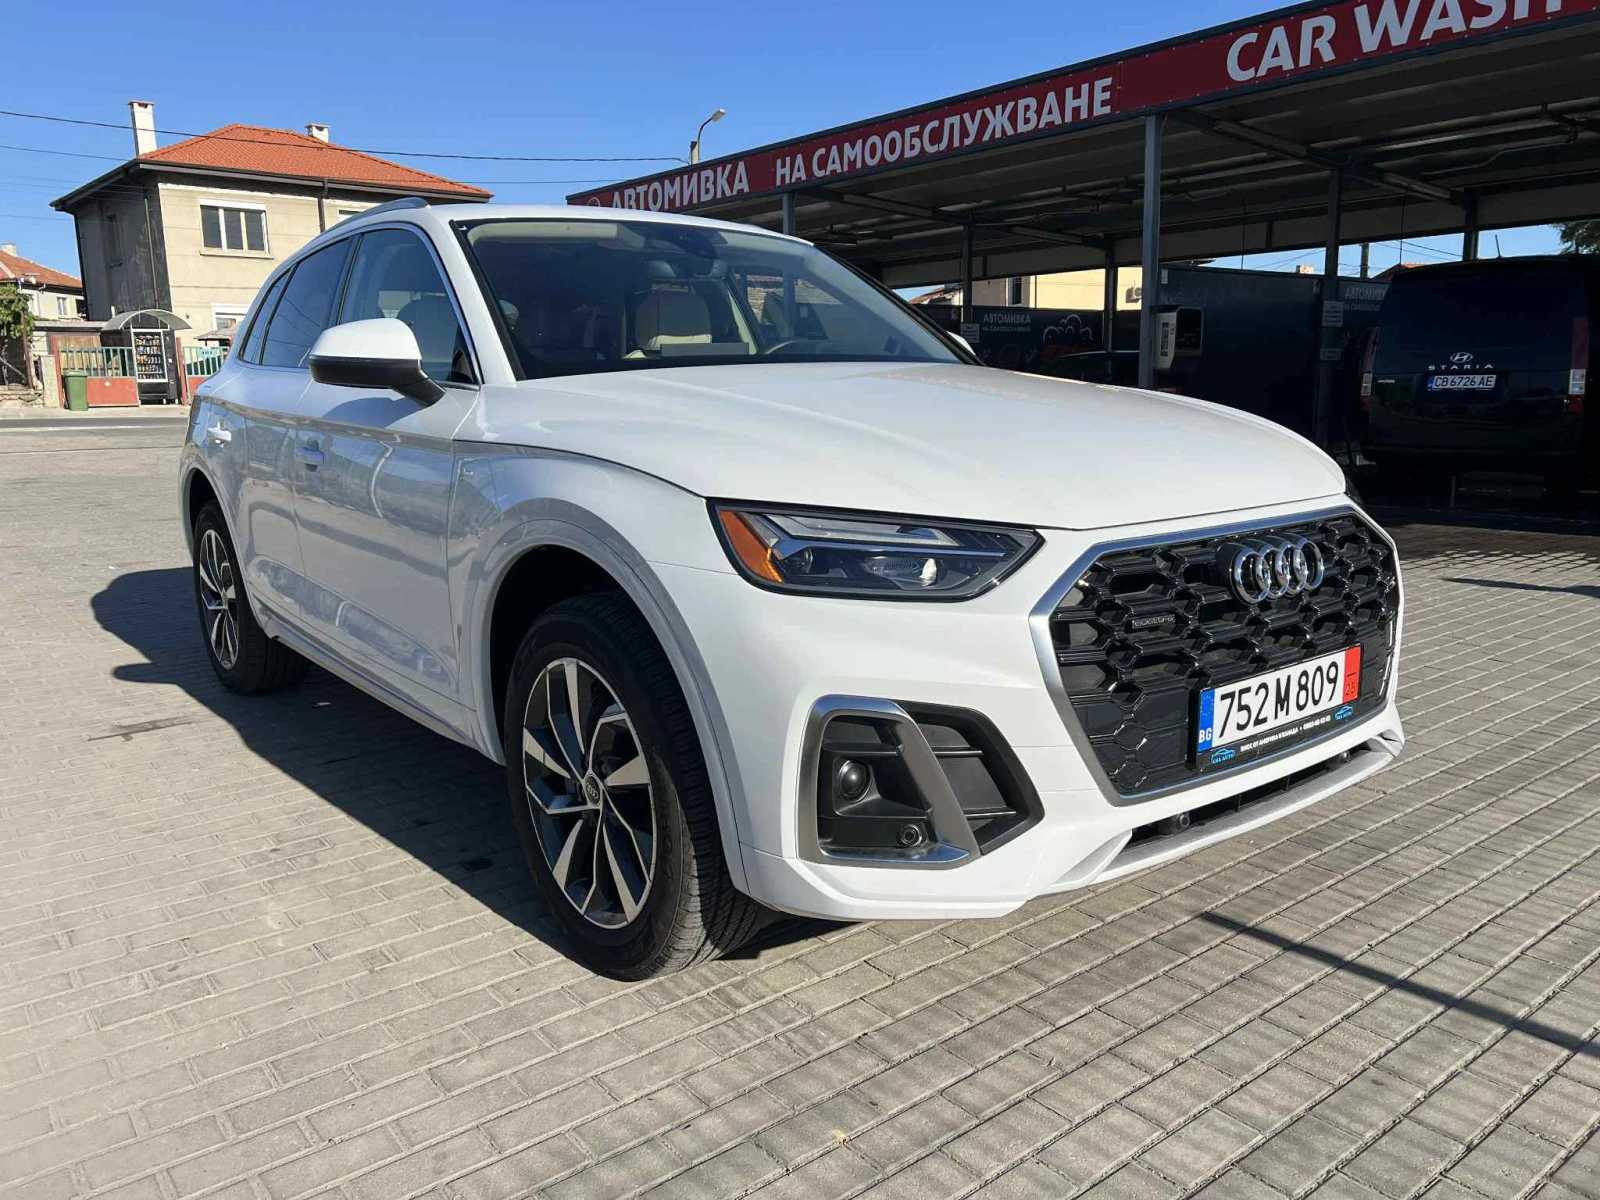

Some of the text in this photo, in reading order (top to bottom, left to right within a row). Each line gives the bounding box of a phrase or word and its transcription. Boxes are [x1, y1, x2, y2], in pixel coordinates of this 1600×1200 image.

[1226, 15, 1336, 82] CAR
[612, 77, 1114, 212] АВТОМИВКА НА САМООБСЛУЖВАНЕ
[983, 313, 1031, 324] АВТОМИВКА
[1198, 728, 1212, 743] BG
